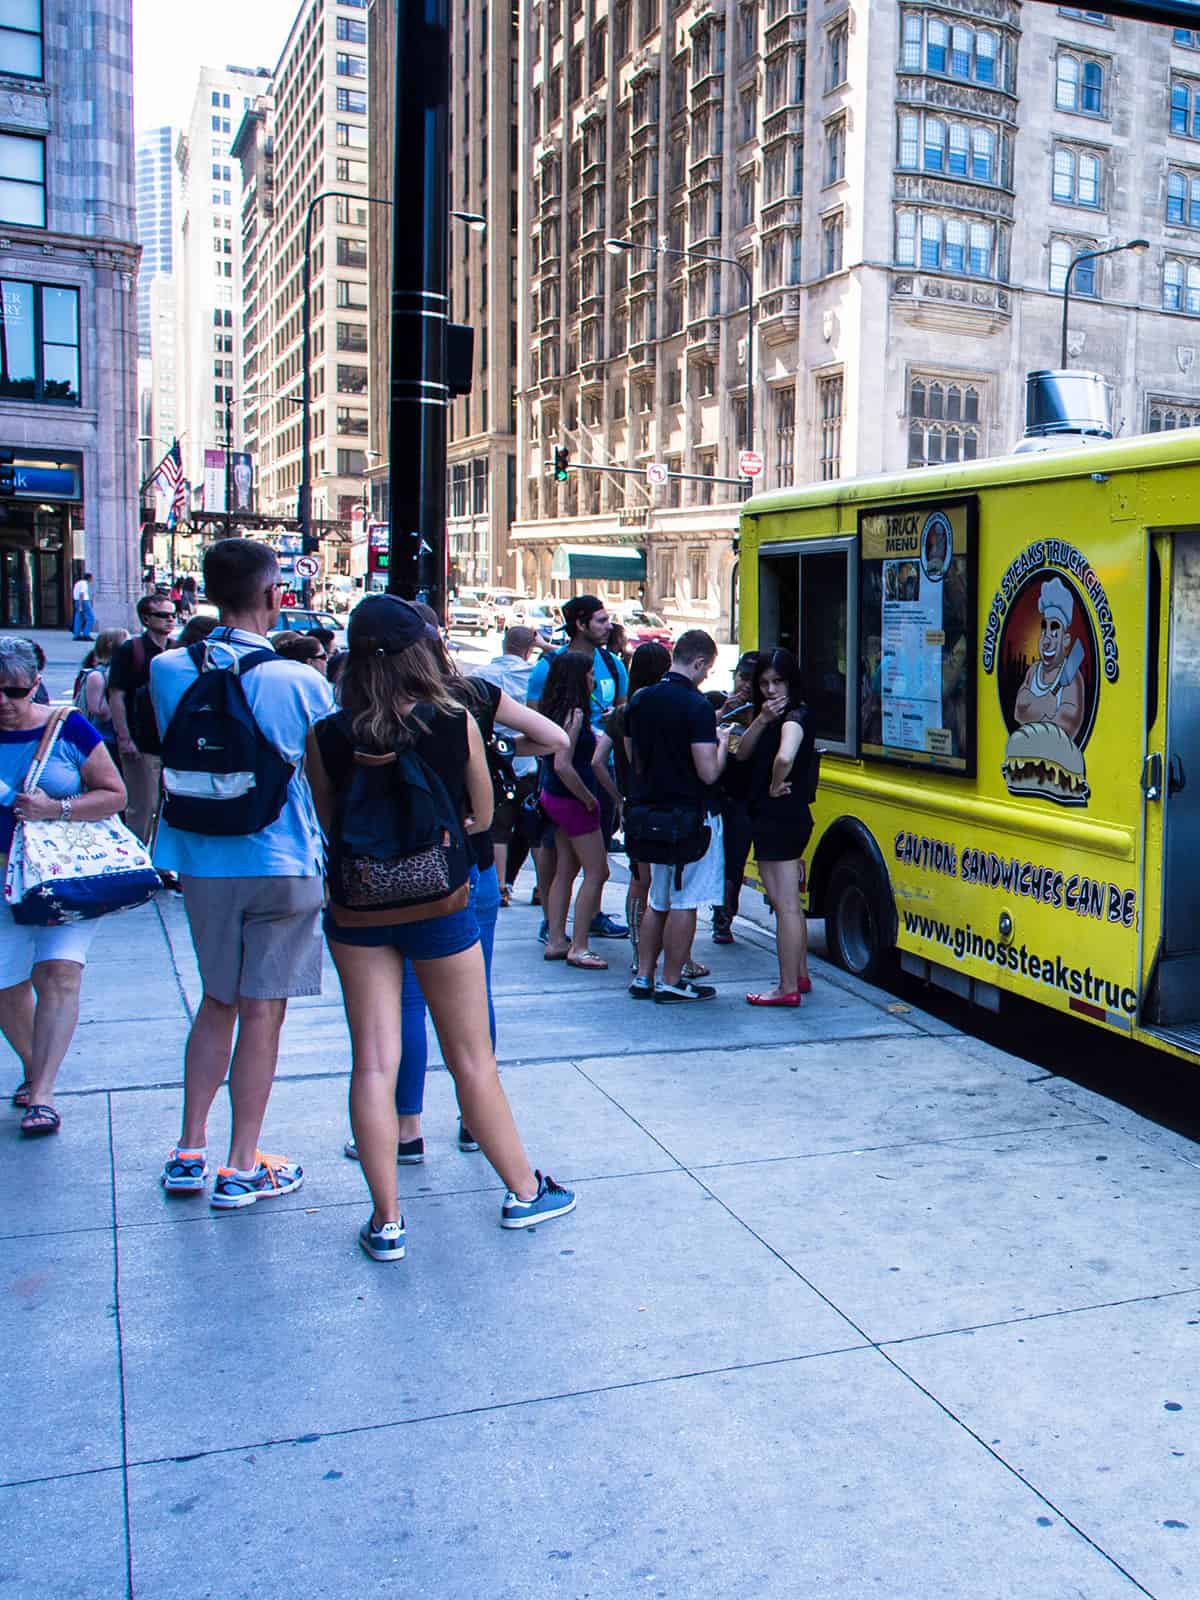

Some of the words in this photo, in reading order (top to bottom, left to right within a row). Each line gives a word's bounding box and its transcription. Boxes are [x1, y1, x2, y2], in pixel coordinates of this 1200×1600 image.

[886, 515, 919, 537] TRUCK
[886, 536, 918, 552] MENU
[982, 591, 1006, 673] GINO'S
[1001, 540, 1044, 601] STEAKS
[1044, 538, 1088, 580] TRUCK
[1083, 566, 1119, 682] CHICAGO
[894, 832, 957, 877] CAUTION:
[961, 848, 1063, 910] SANDWICHES
[1064, 874, 1108, 921] CAN
[1107, 882, 1136, 928] BE
